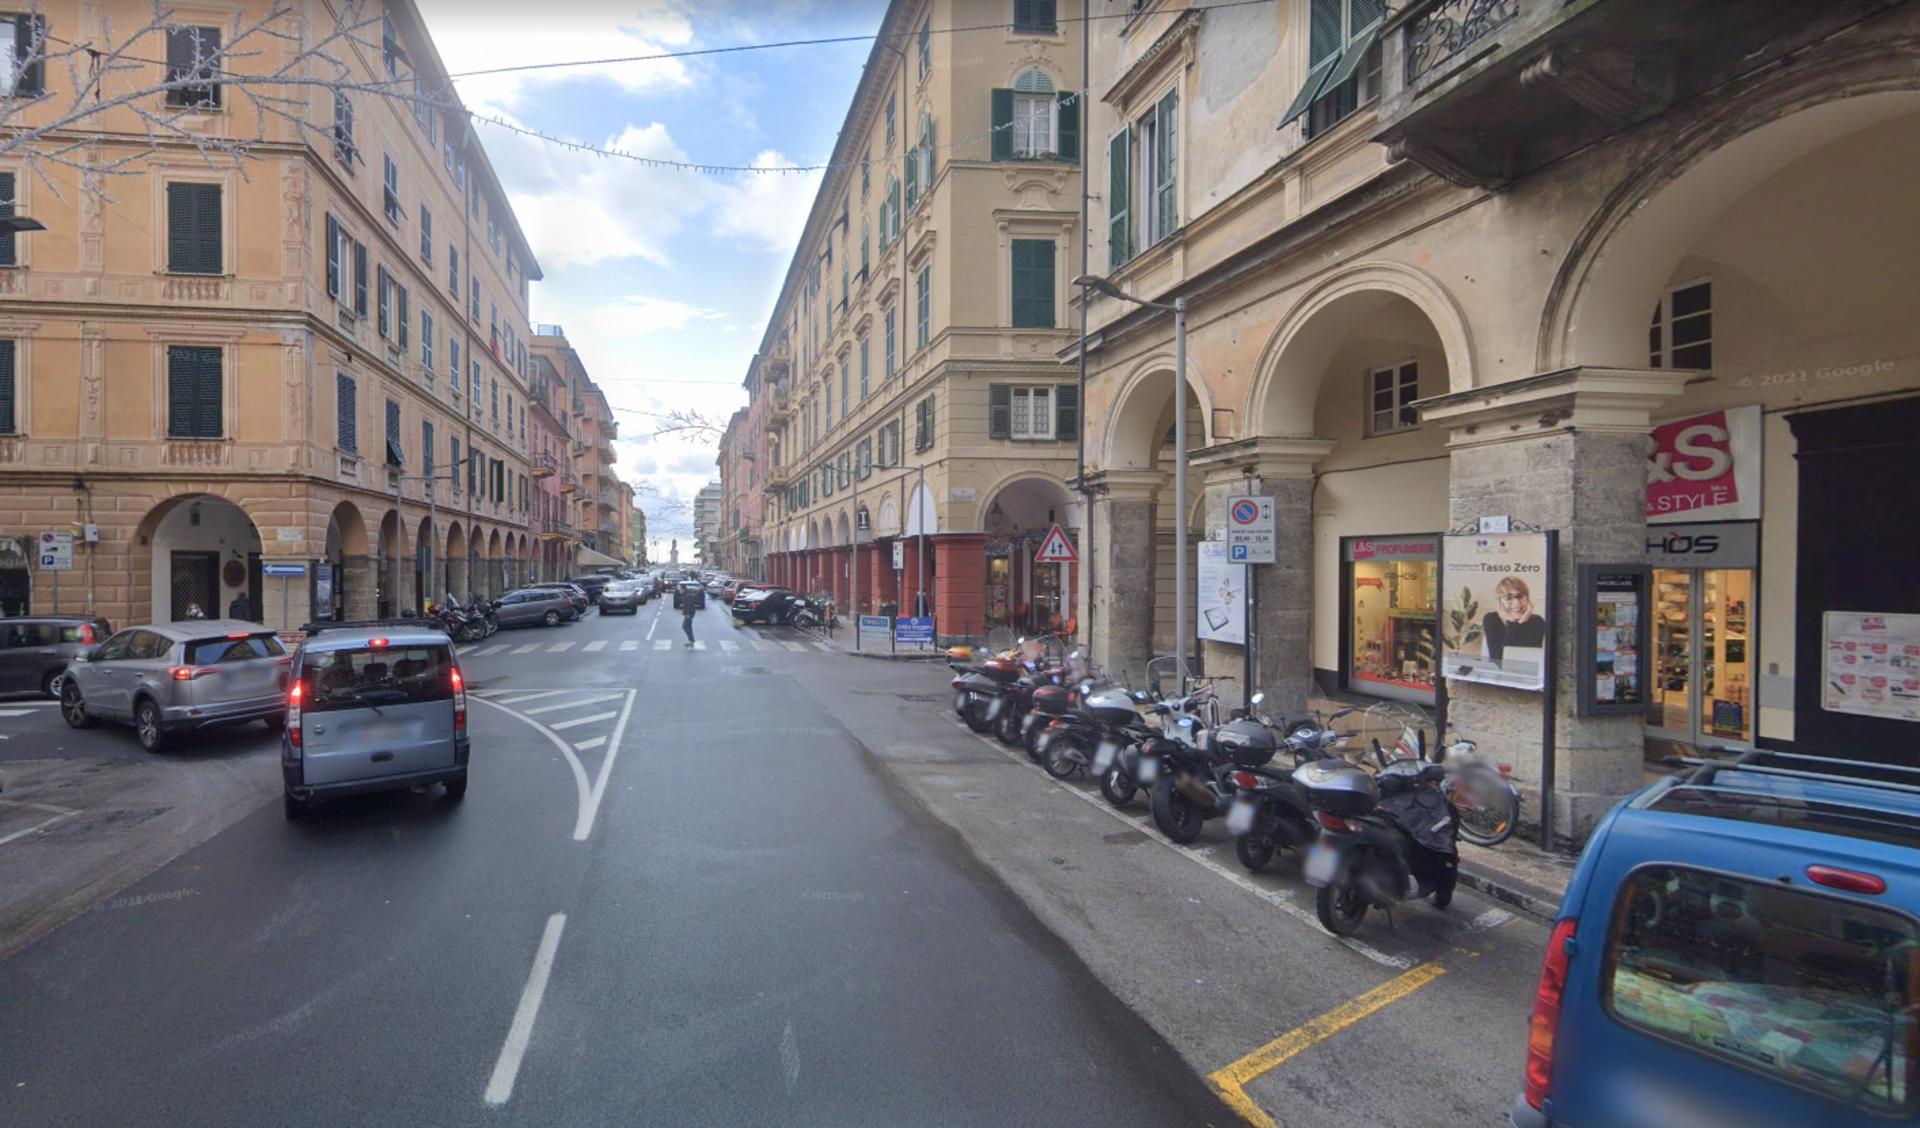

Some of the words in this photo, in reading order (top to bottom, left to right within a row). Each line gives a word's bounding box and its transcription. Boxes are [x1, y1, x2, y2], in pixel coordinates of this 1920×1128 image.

[1235, 547, 1244, 558] P
[1352, 541, 1374, 553] L&S
[1376, 543, 1436, 554] PROFUMERIE
[1480, 562, 1511, 572] Tasso
[1514, 562, 1541, 572] Zero
